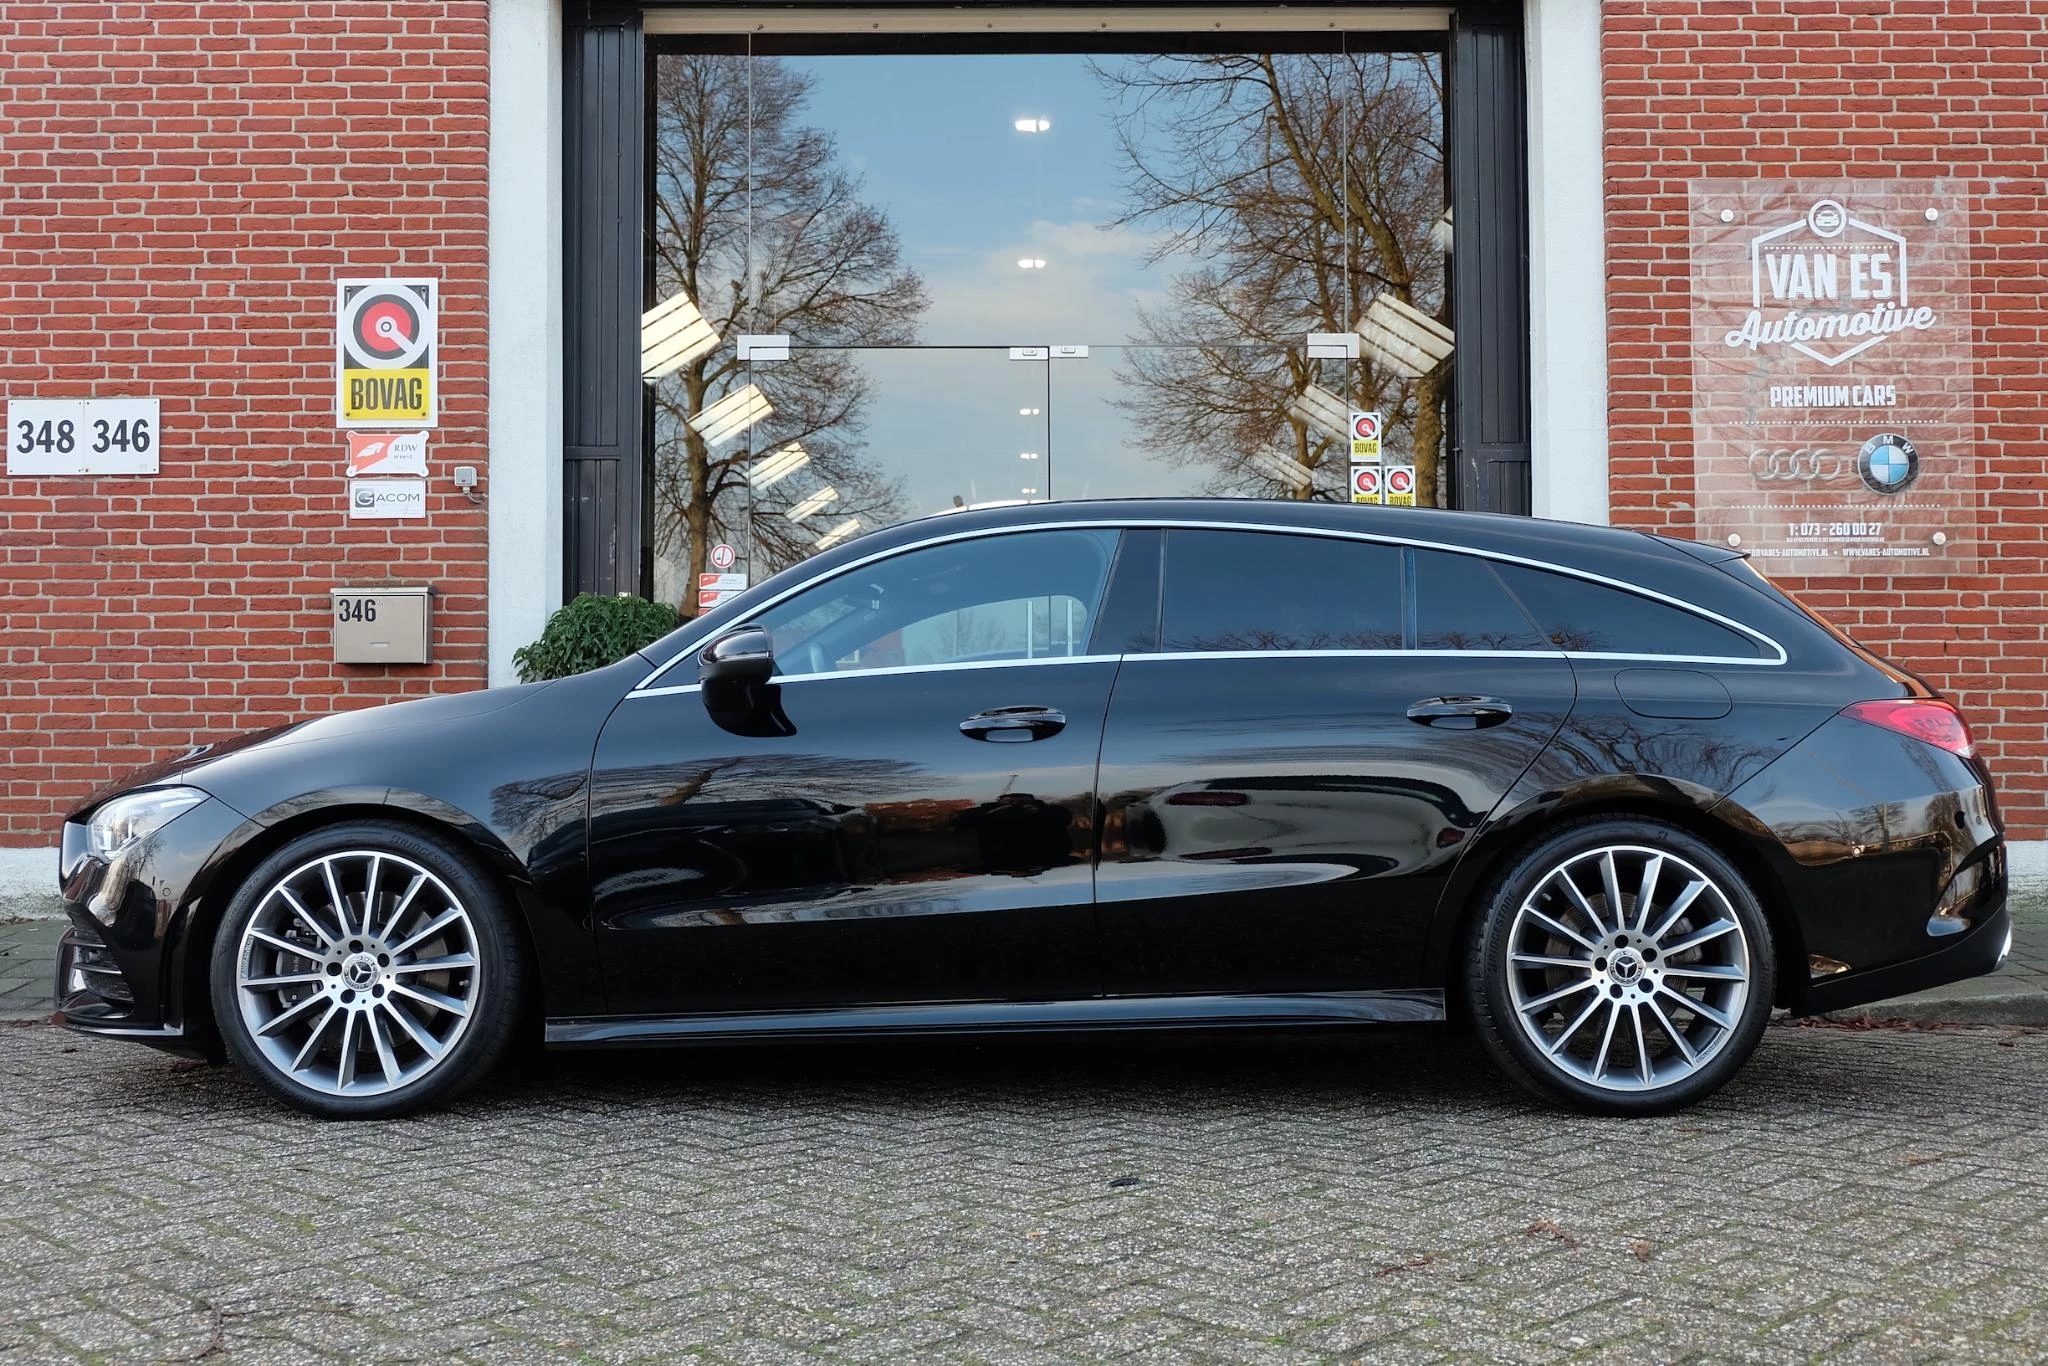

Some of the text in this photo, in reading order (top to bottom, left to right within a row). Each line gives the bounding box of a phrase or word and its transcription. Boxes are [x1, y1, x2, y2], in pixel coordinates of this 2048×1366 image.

[1766, 253, 1893, 299] VAN ES
[1725, 301, 1937, 351] Automotive
[350, 378, 423, 411] BOVAG
[1770, 385, 1896, 408] PREMIUM CARS
[16, 419, 76, 454] 348
[92, 418, 151, 453] 346
[1864, 435, 1914, 454] BMW
[394, 444, 418, 452] RDW
[1354, 442, 1377, 454] BOVAG
[1788, 523, 1799, 536] T:
[1801, 523, 1820, 536] 073
[1829, 523, 1851, 536] 260
[1852, 523, 1866, 536] 00
[1868, 523, 1881, 536] 27
[339, 599, 376, 622] 346
